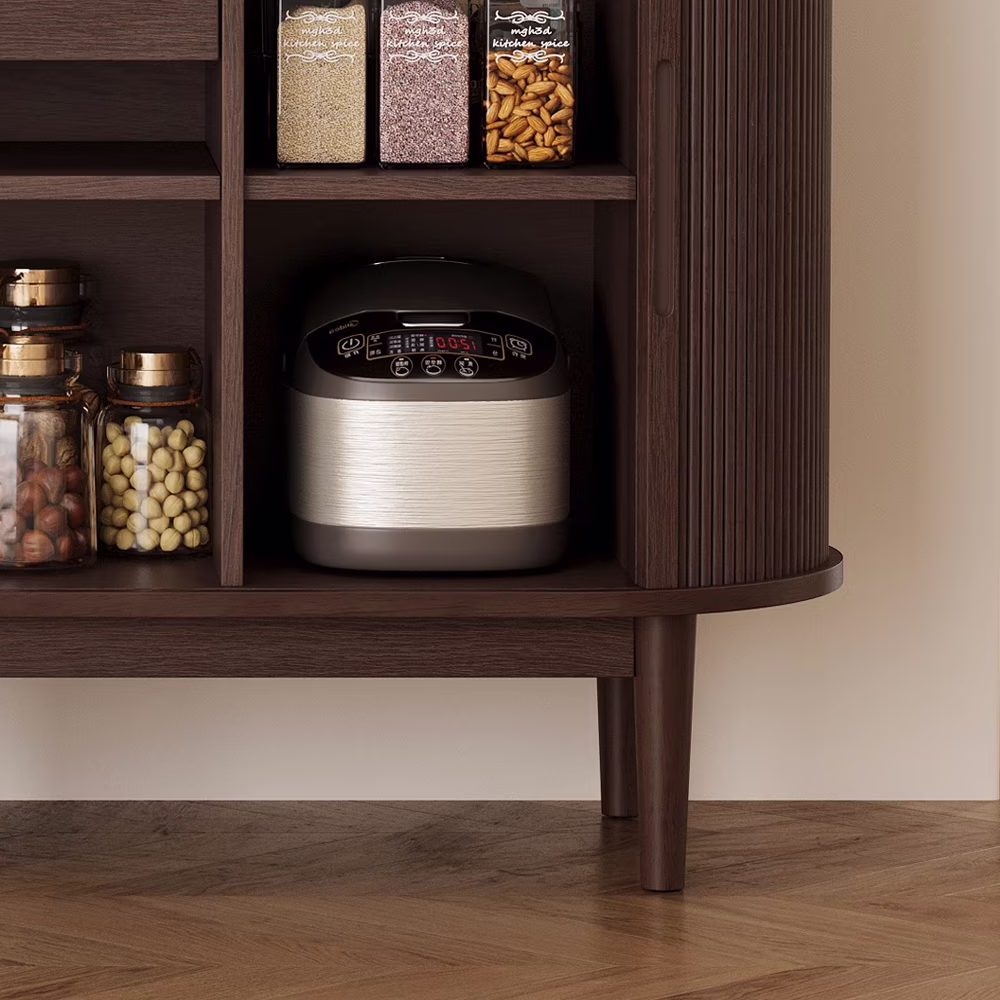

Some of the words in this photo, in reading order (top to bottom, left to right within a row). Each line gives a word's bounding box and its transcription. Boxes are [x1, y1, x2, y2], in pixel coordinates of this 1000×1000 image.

[283, 39, 327, 48] kitchen
[331, 39, 361, 49] spice
[386, 39, 430, 48] kitchen
[434, 39, 464, 49] spice
[492, 39, 536, 48] kitchen
[540, 38, 570, 49] spice
